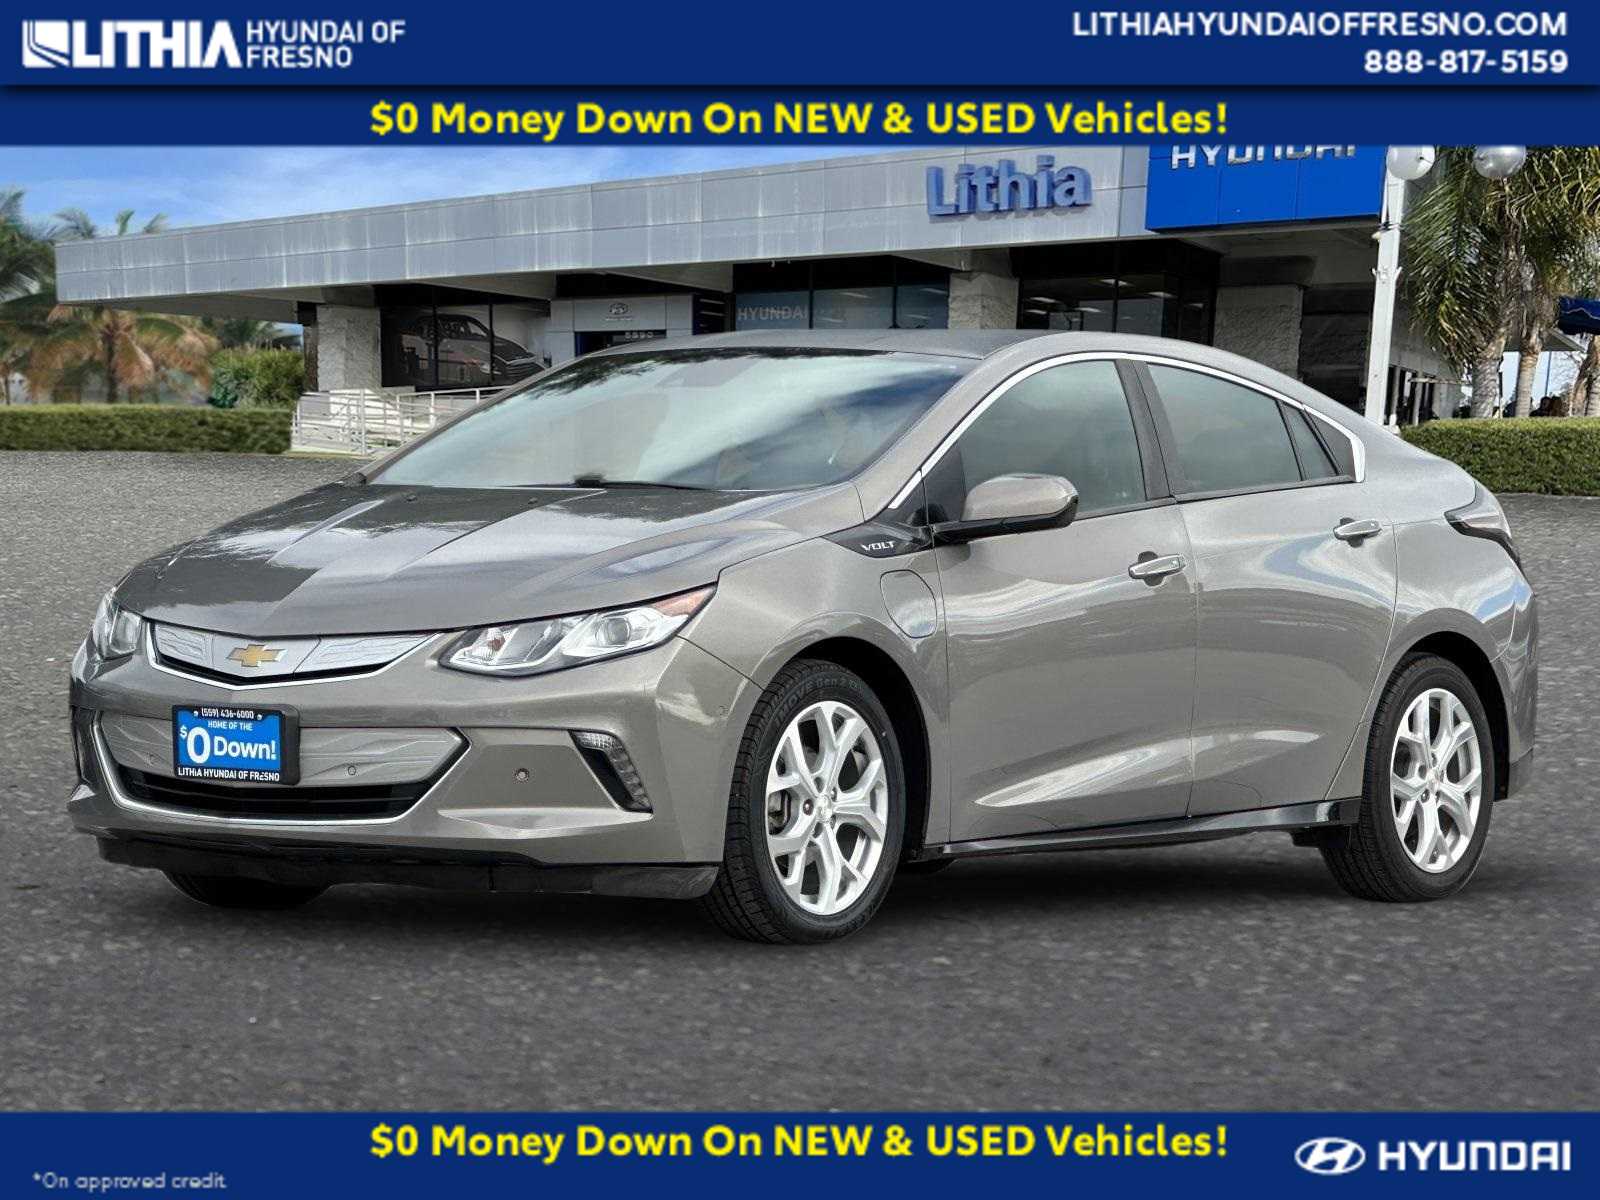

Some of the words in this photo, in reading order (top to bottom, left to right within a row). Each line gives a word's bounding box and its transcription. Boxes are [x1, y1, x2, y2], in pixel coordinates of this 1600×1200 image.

[926, 155, 1093, 215] Lithia
[861, 540, 895, 551] VOLT
[201, 707, 219, 718] (559)
[220, 709, 254, 719] 436-6000
[208, 720, 226, 729] HOME
[228, 721, 238, 730] OF
[240, 722, 253, 731] THE
[213, 736, 277, 760] Down!
[178, 767, 202, 777] LITHIA
[203, 769, 237, 779] HYUNDAI
[238, 770, 248, 780] OF
[249, 771, 280, 781] FRESNO
